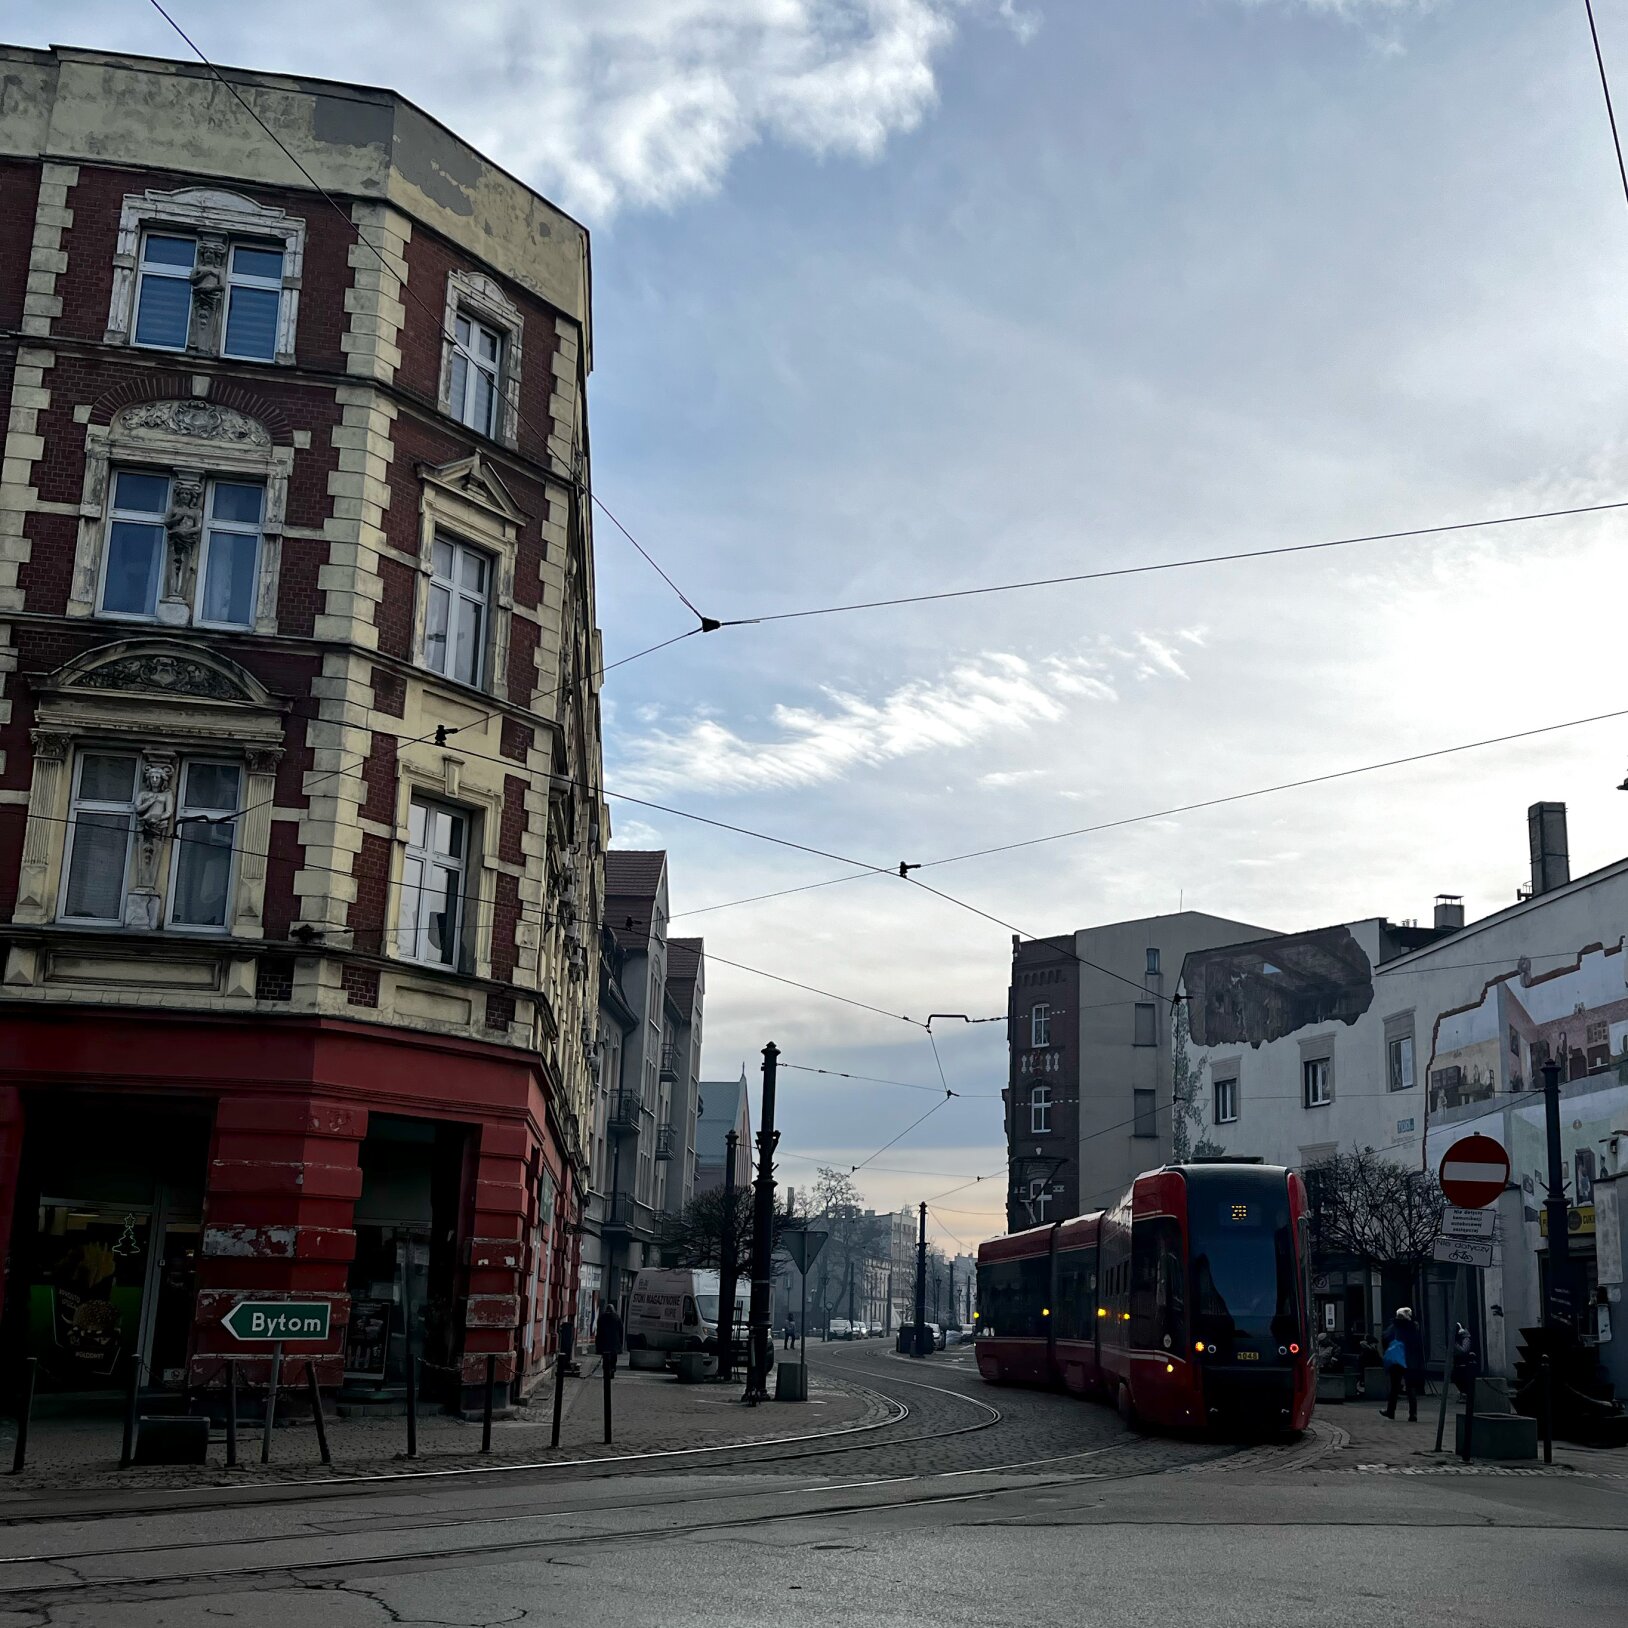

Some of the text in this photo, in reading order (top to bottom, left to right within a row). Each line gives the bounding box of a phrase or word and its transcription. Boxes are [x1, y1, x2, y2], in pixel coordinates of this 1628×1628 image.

[1436, 1239, 1489, 1253] Nie dotyczy
[252, 1312, 321, 1336] Bytom
